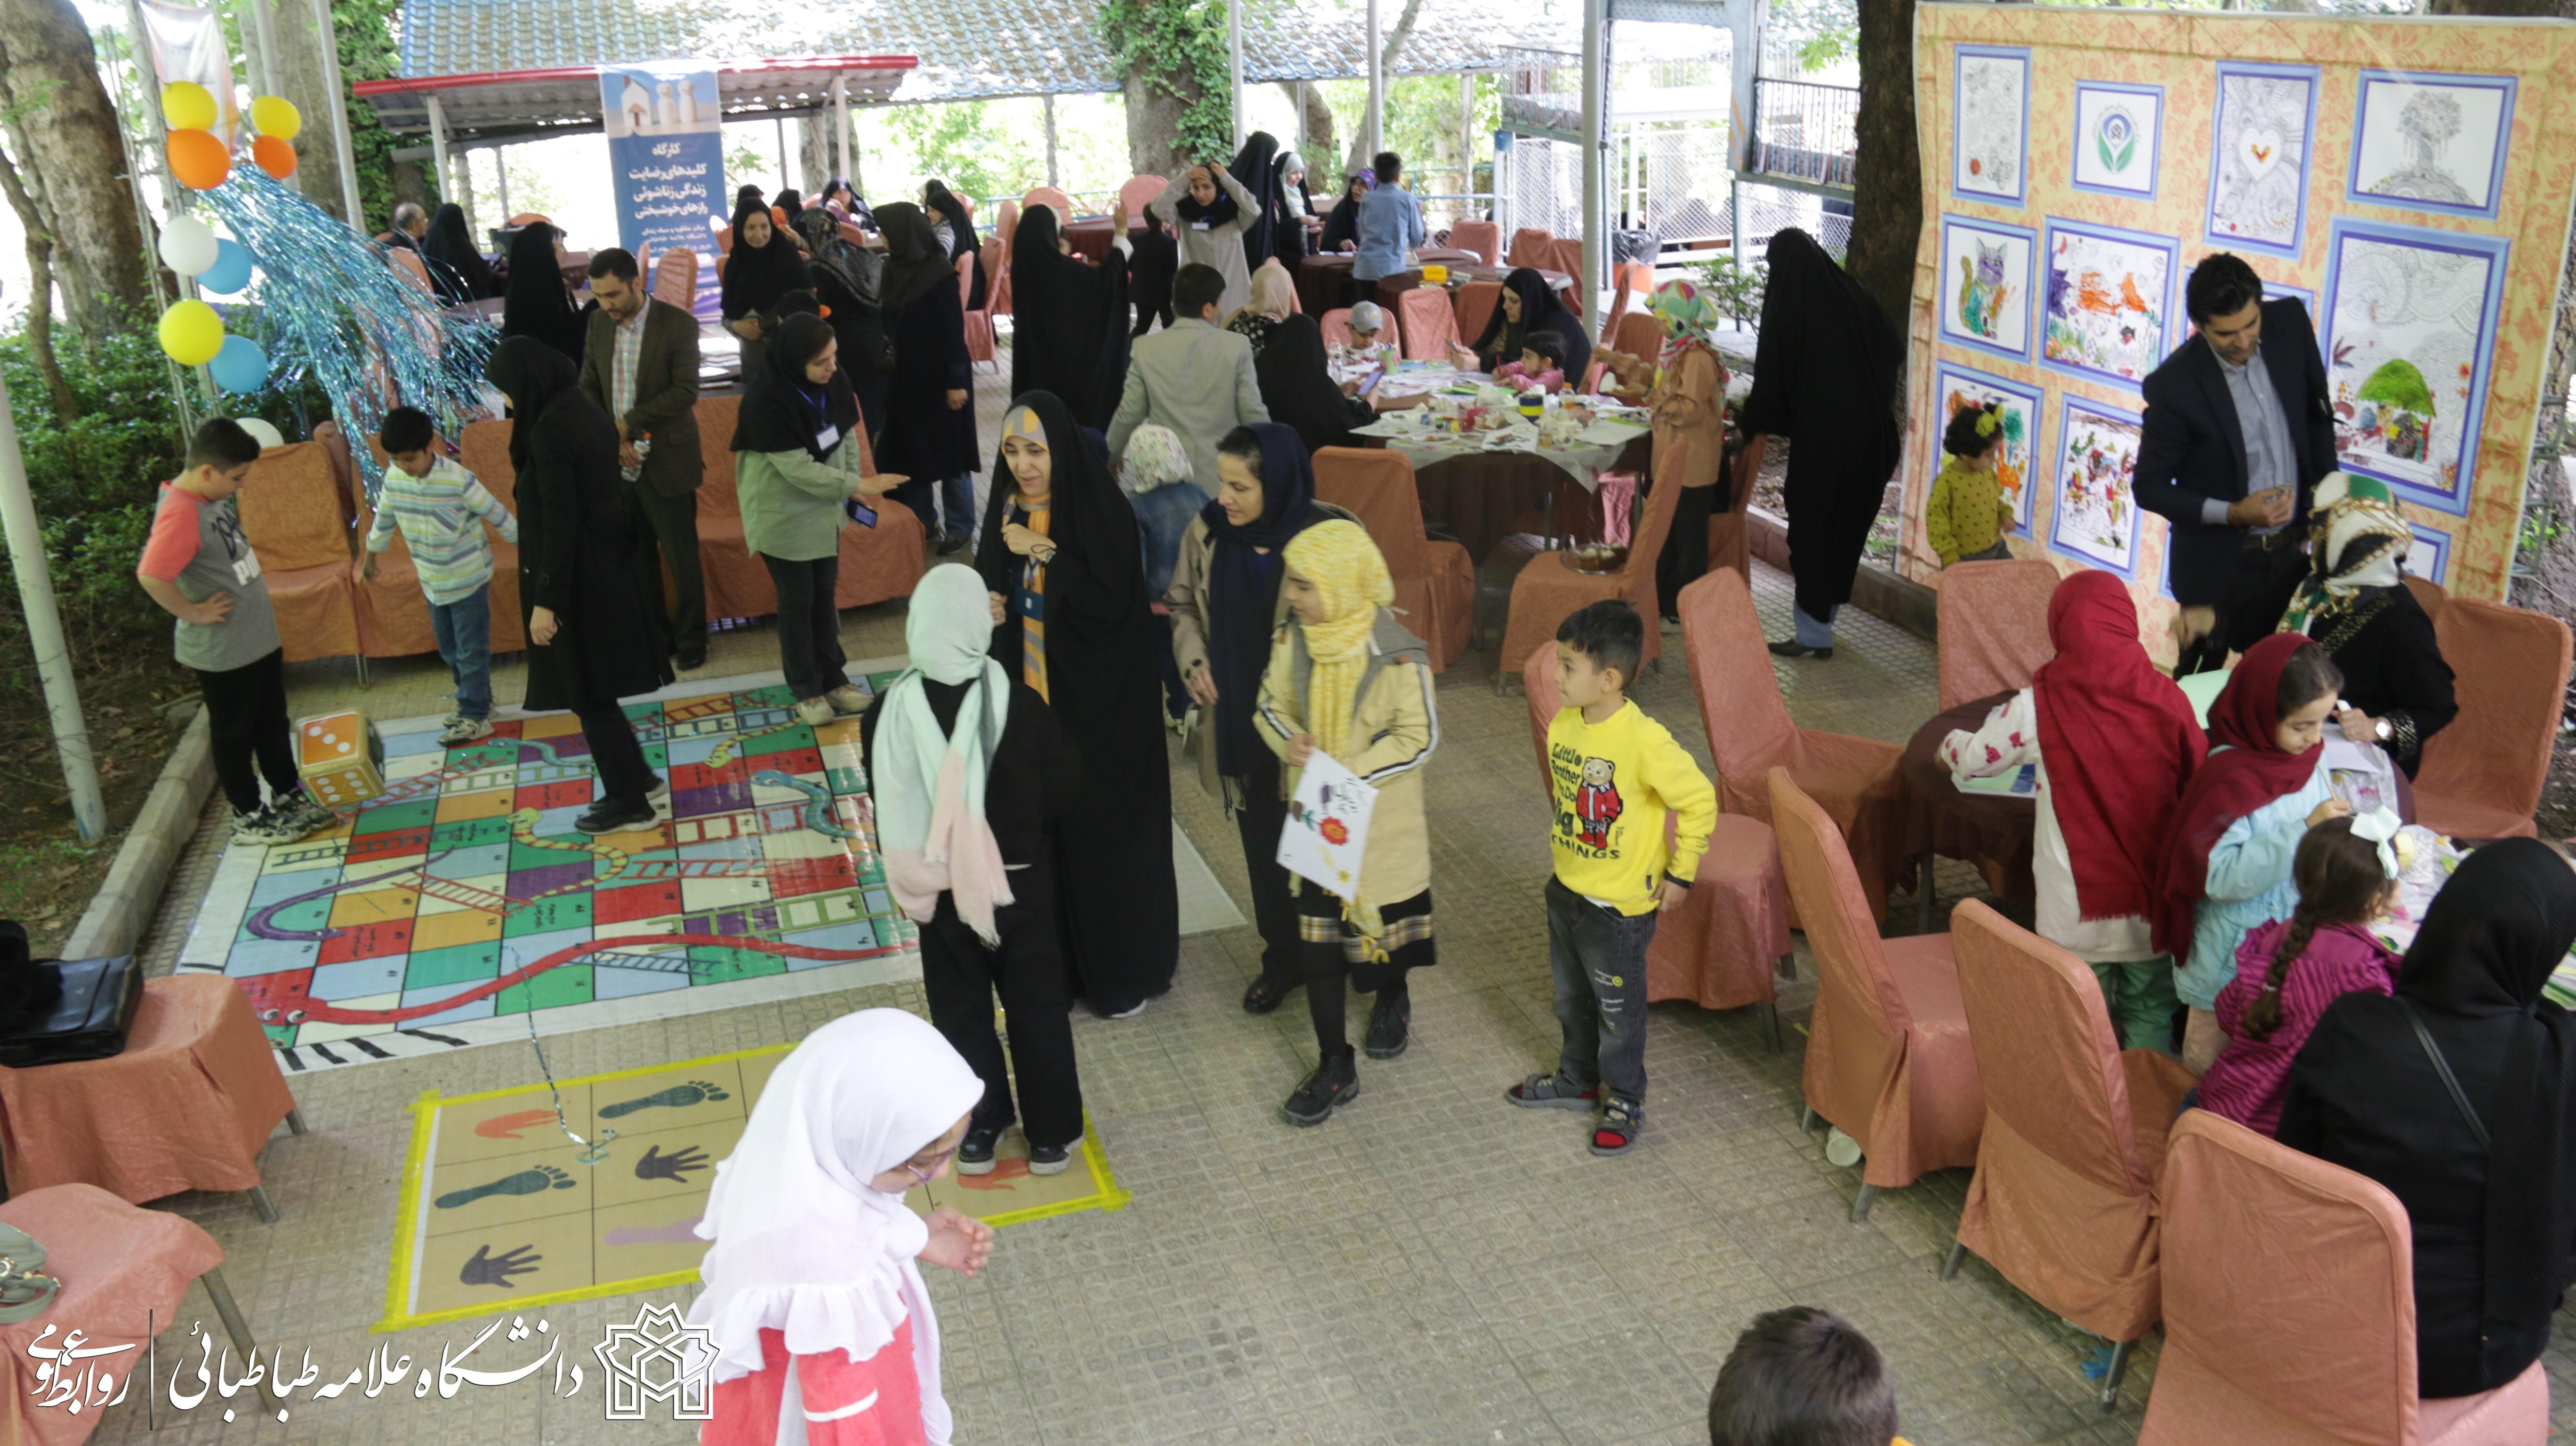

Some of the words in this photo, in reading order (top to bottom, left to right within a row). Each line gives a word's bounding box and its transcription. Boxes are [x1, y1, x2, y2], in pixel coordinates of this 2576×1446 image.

[652, 142, 681, 158] کارگاه
[628, 166, 666, 182] رضایت
[664, 163, 707, 180] کلیدهای
[675, 182, 707, 200] زندگی
[635, 203, 681, 220] خوشبختی
[679, 201, 708, 216] رازهای
[1551, 834, 1620, 859] THINGS
